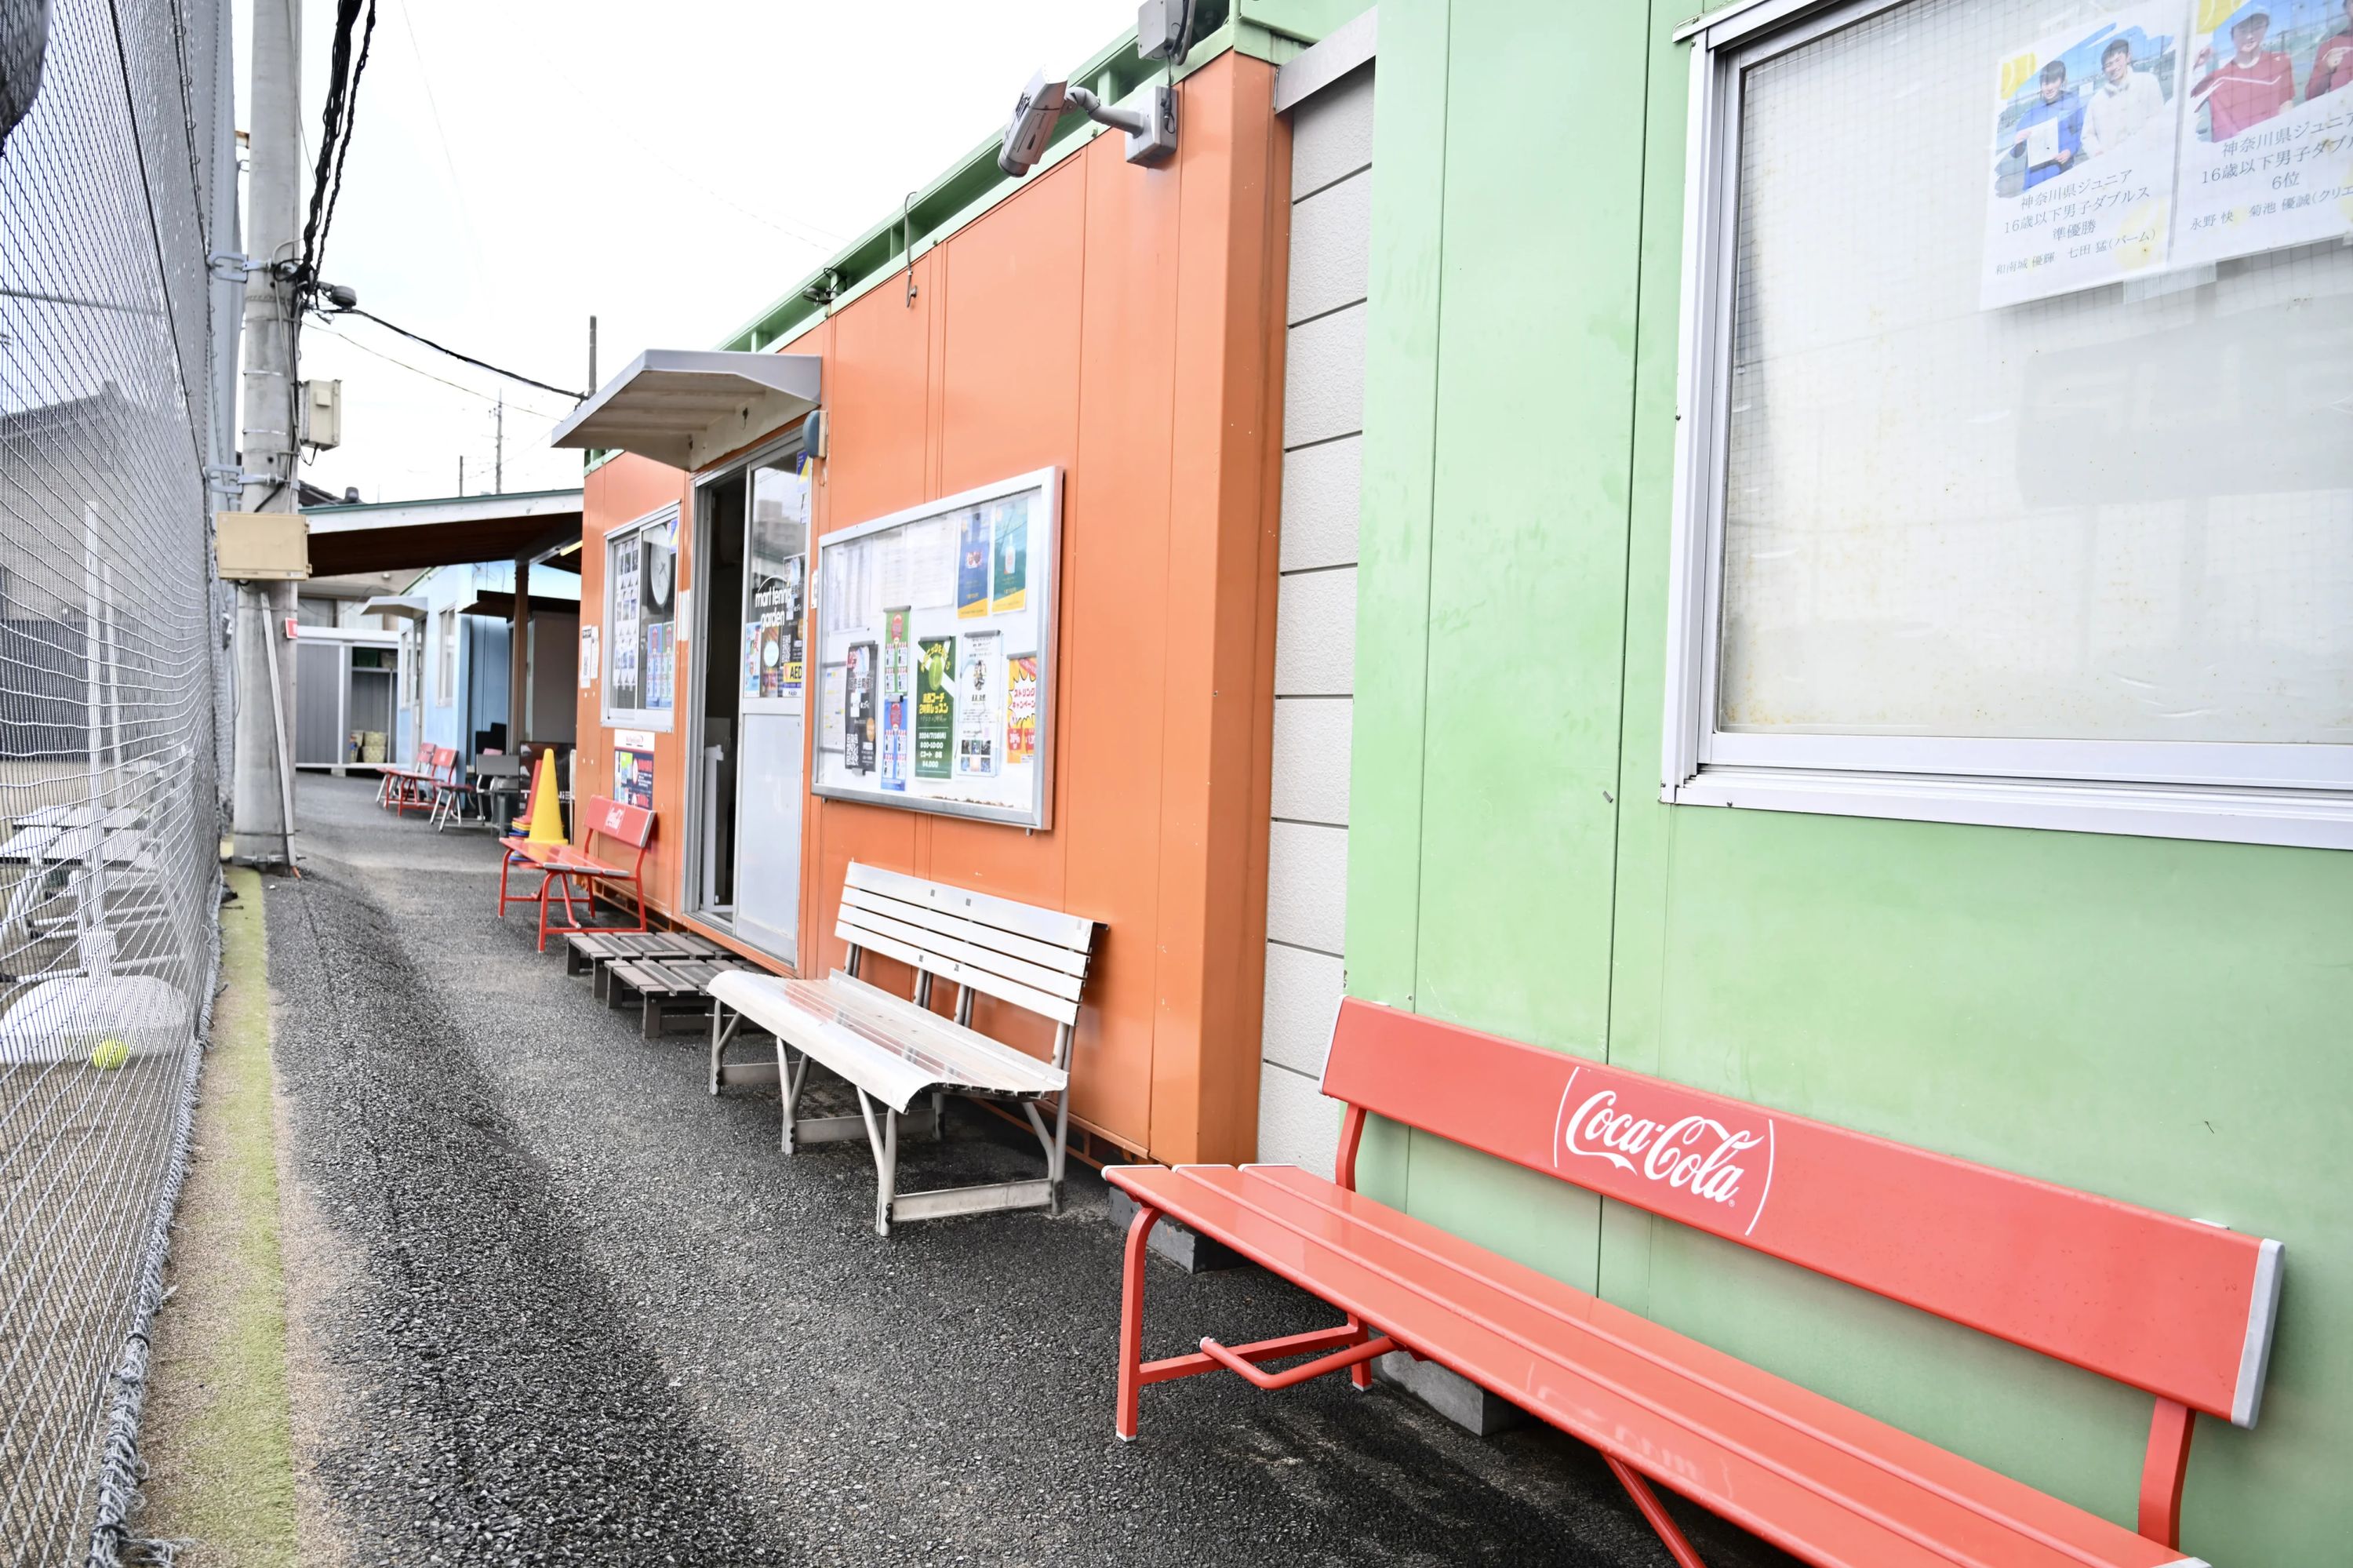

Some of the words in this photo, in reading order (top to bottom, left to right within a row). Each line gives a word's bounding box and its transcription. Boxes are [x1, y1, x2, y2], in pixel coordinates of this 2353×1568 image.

[2021, 169, 2133, 210] 神奈川県ジュニア
[2271, 171, 2300, 190] 6位
[2004, 187, 2150, 234] 16歳以下男子ダブルス
[2053, 219, 2097, 242] 準優勝
[755, 586, 772, 608] mart
[772, 584, 792, 606] tennis
[761, 607, 785, 632] garden
[790, 666, 802, 679] AED
[1013, 687, 1035, 698] ストリング
[1566, 1090, 1765, 1203] Coca-Cola
